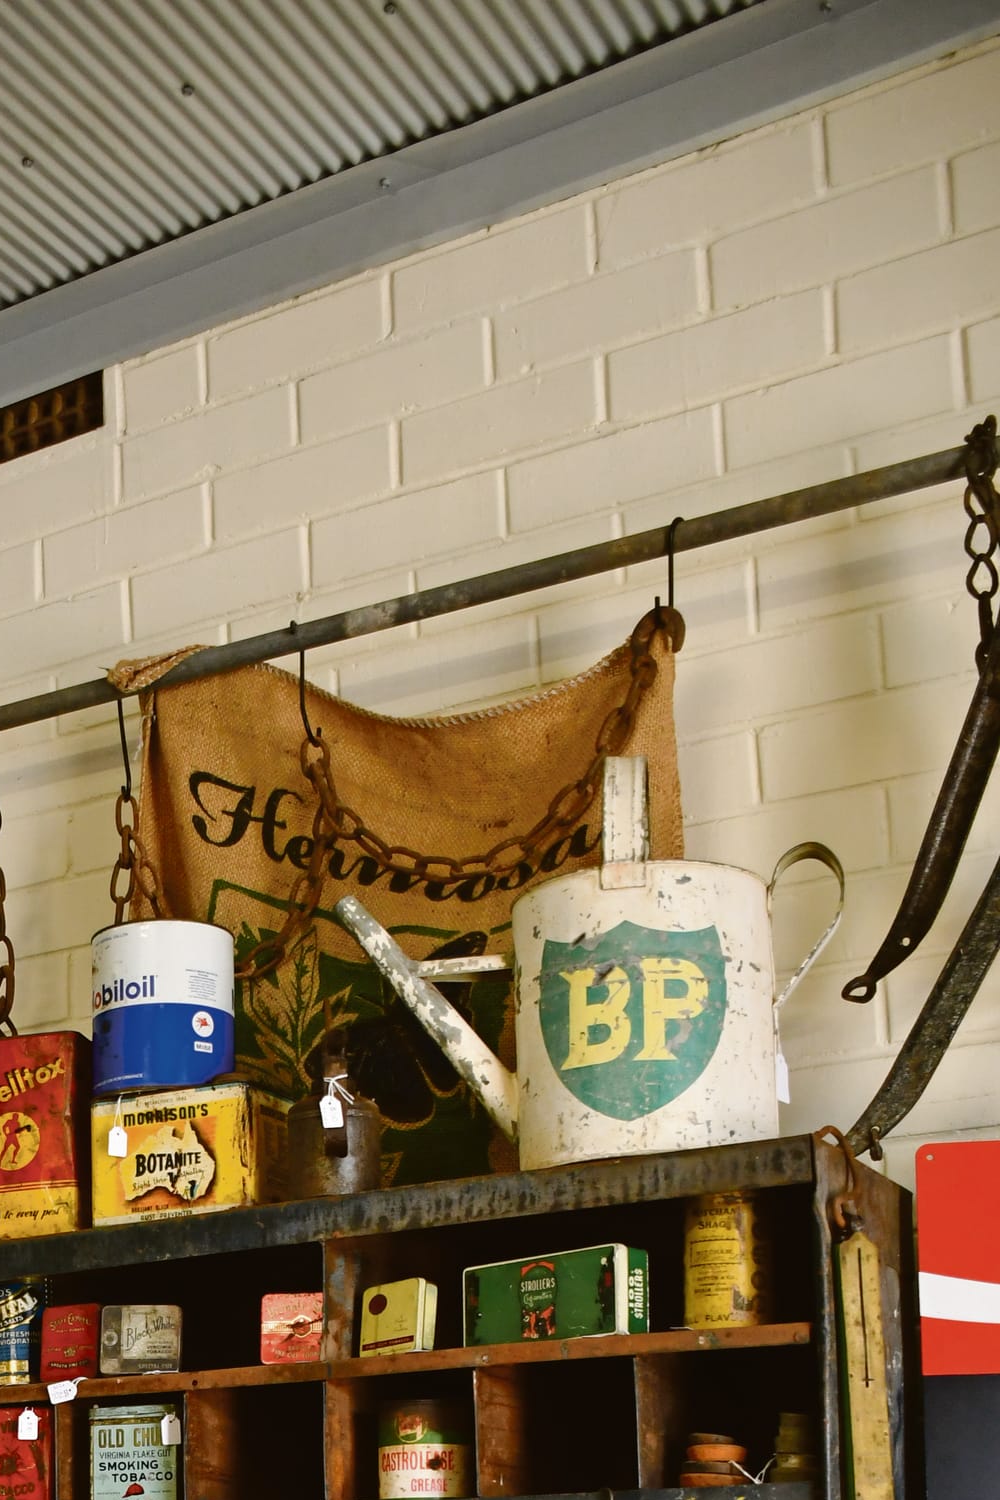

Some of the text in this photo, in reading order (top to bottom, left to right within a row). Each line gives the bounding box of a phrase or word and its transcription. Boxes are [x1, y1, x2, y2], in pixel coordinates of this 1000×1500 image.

[93, 974, 155, 1010] obiloil
[558, 956, 709, 1071] BP
[134, 1151, 202, 1178] BOTANITE
[520, 1277, 556, 1293] STROLLERS
[633, 1267, 644, 1320] STROLLERS
[705, 1313, 731, 1322] FLAV
[98, 1426, 163, 1449] OLD CHU
[99, 1450, 131, 1460] VIRGINIA
[132, 1449, 156, 1459] FLAKE
[98, 1459, 159, 1472] SMOKING
[111, 1471, 173, 1483] TOBACCO
[410, 1478, 448, 1493] GREASE
